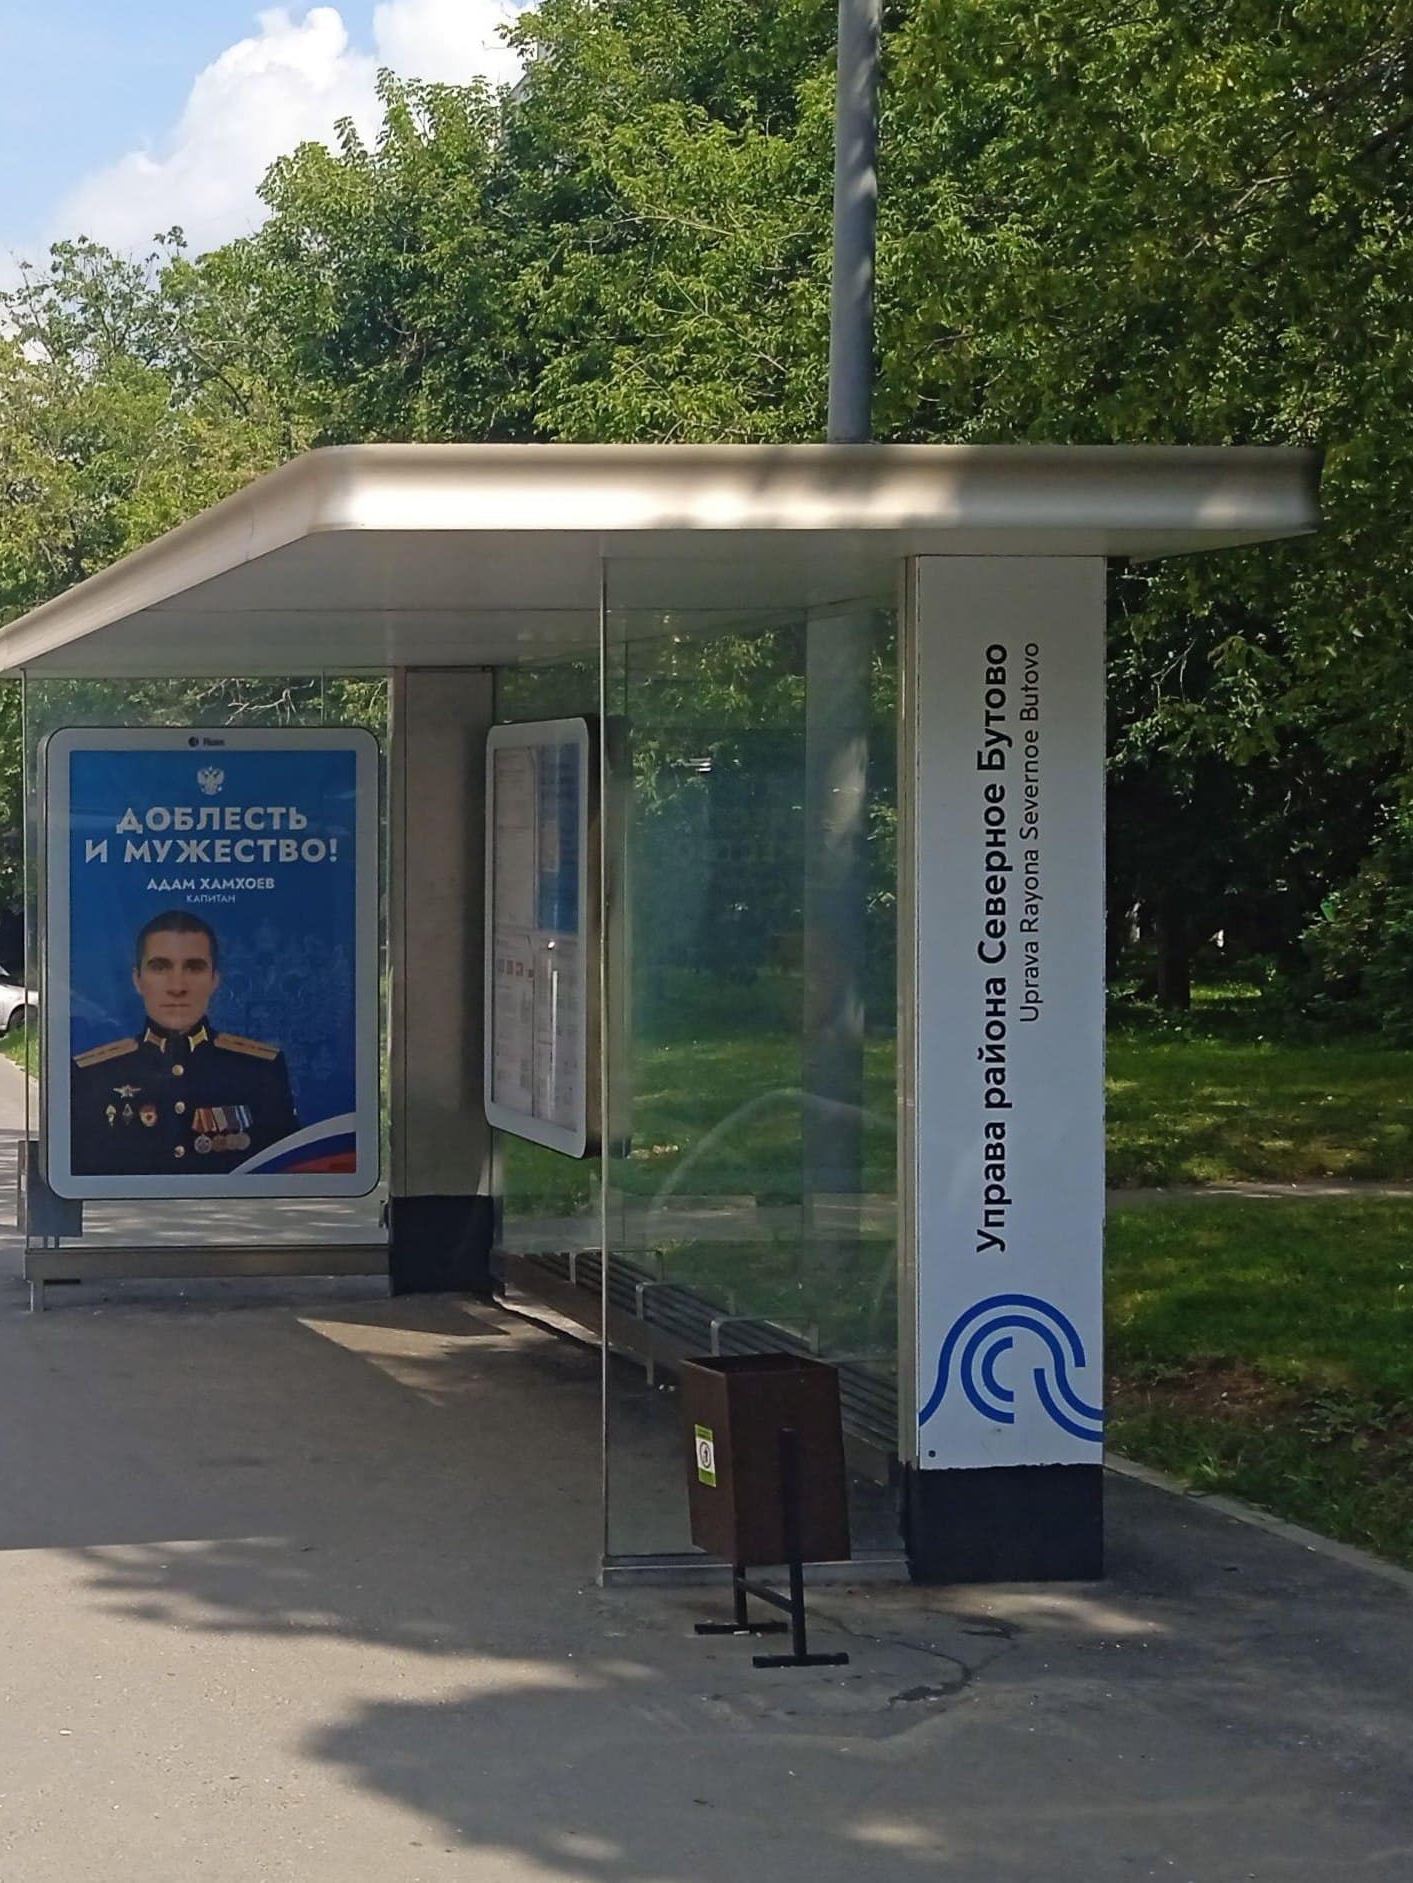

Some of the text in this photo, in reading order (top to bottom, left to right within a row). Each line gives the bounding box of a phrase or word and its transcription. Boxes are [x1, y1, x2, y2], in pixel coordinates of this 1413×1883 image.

[116, 806, 308, 834] ДОБЛЕСТЬ
[1019, 641, 1044, 1022] Uprava Rayona Severnoe Butovo
[85, 838, 338, 864] И МУЖЕСТВО!
[147, 877, 276, 891] АДАМ ХАМХОЕВ
[186, 894, 236, 904] КАПИТАН
[976, 639, 1014, 1253] Управа района Северное Бутово
